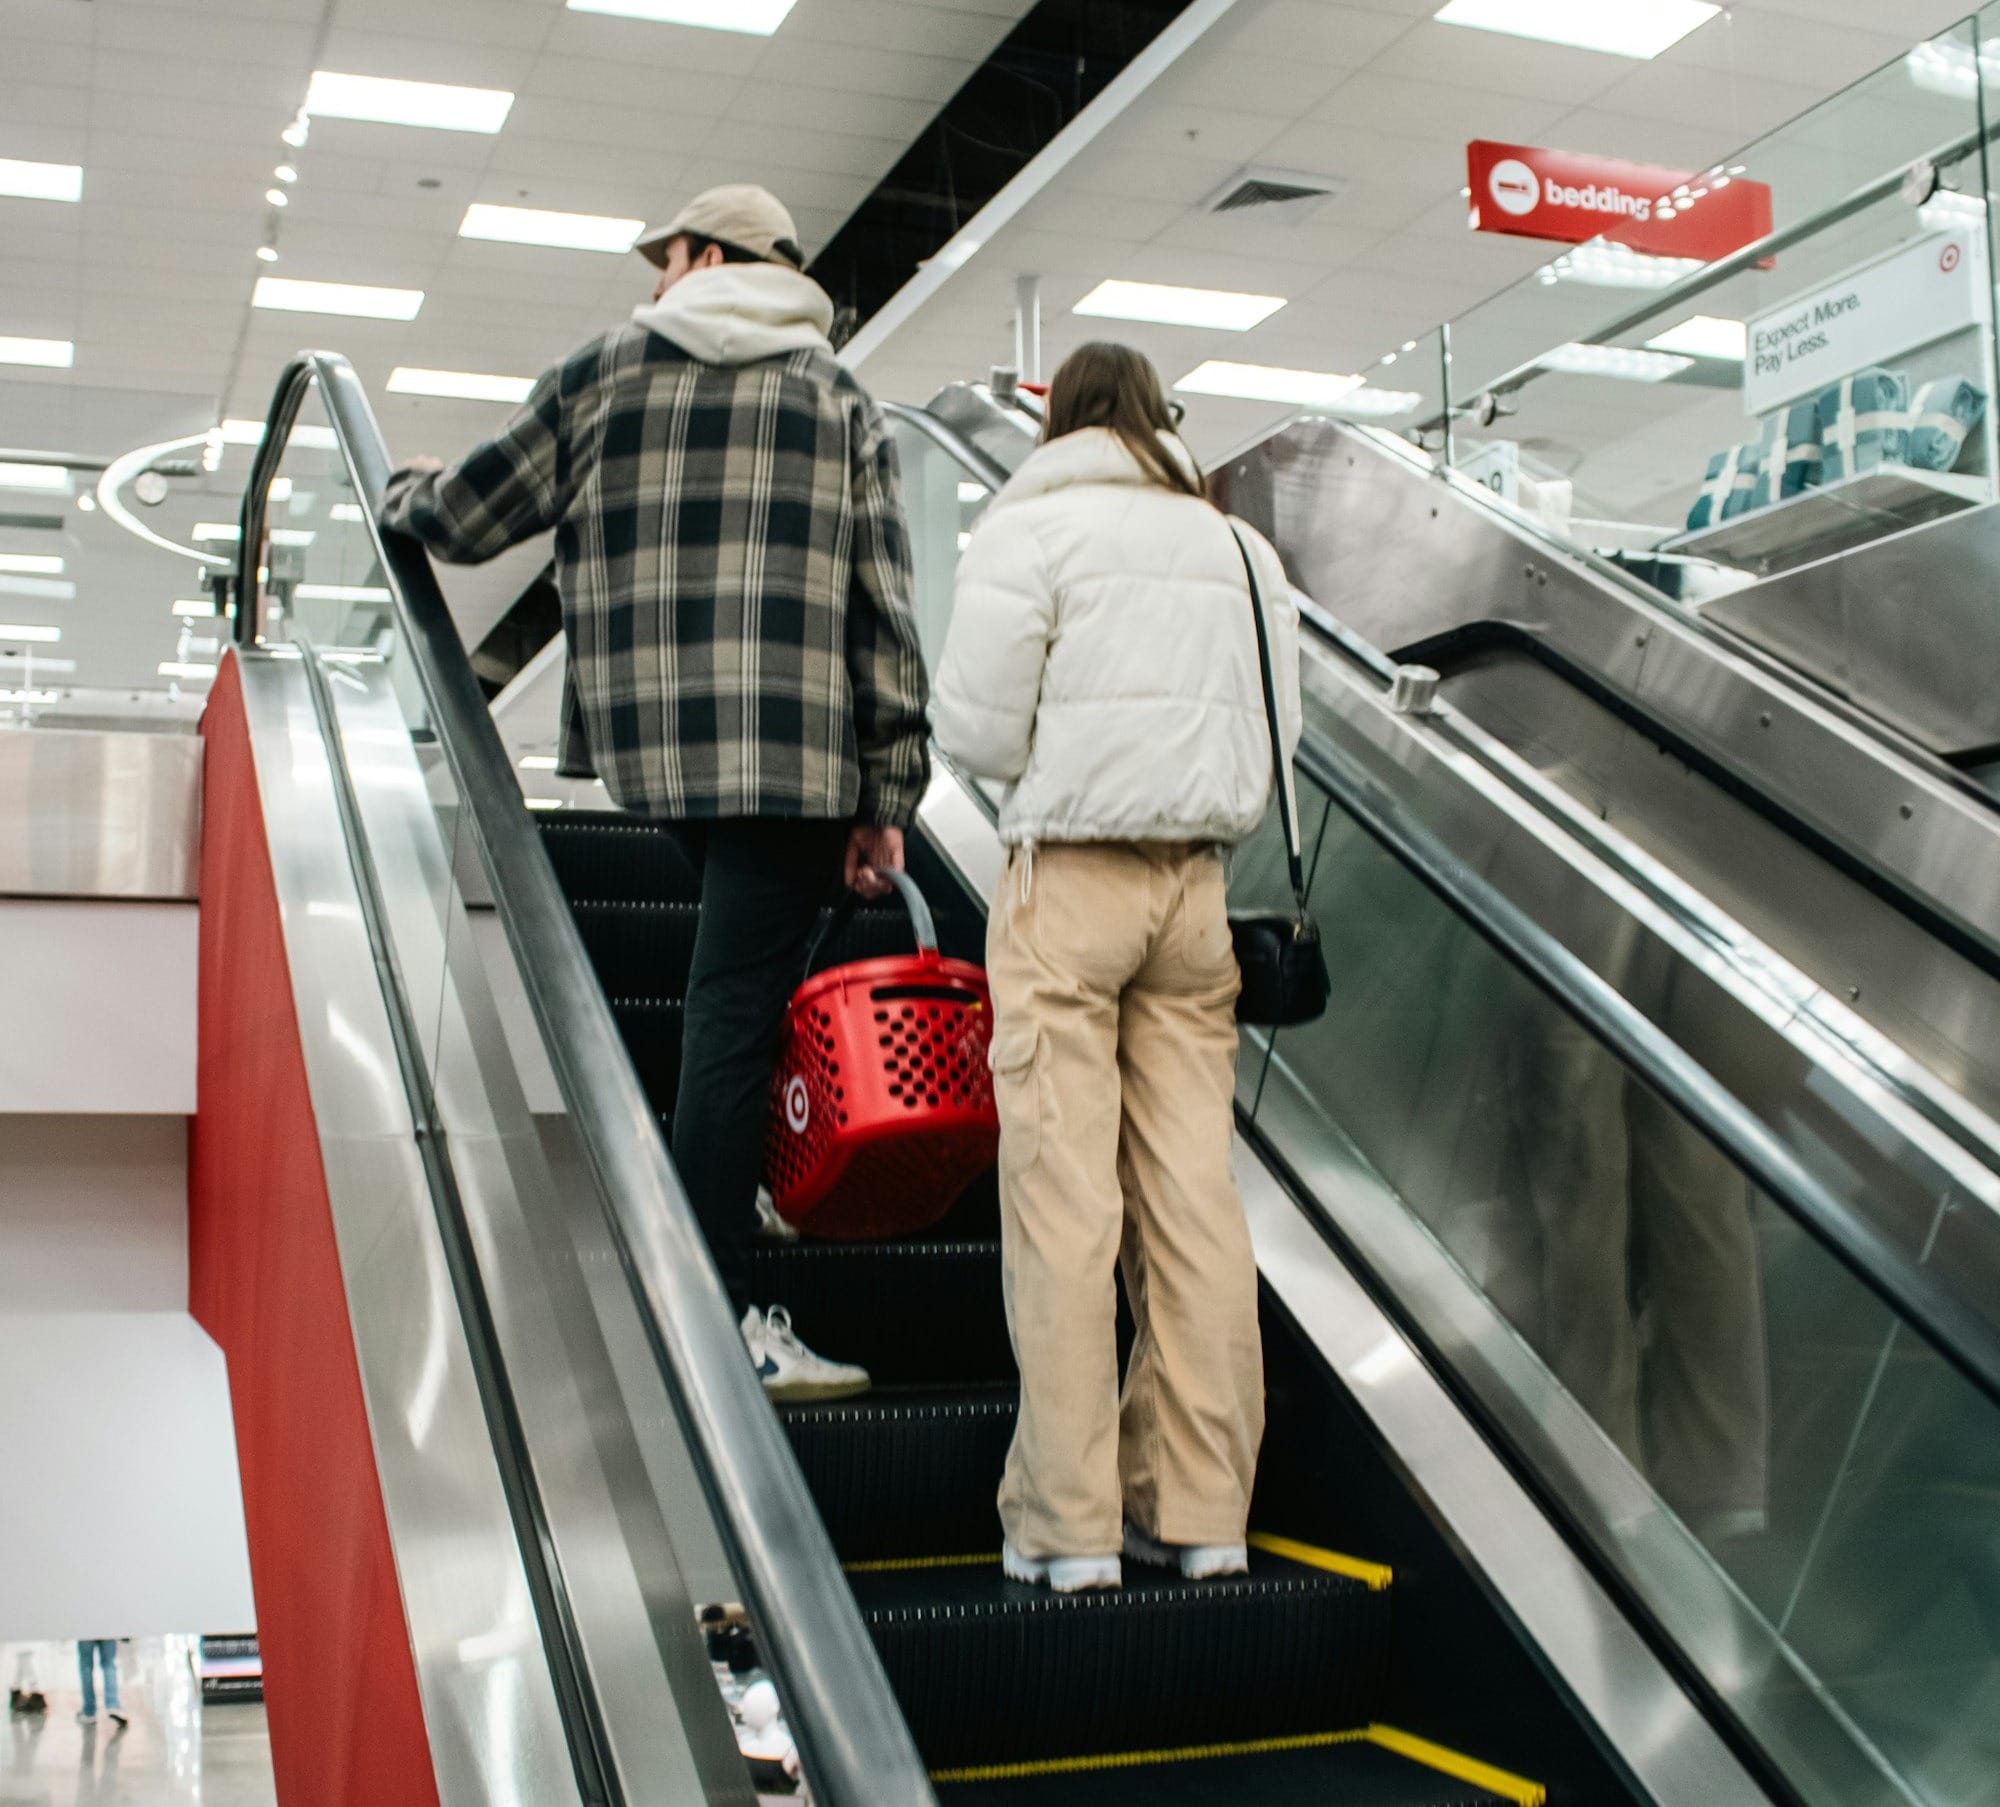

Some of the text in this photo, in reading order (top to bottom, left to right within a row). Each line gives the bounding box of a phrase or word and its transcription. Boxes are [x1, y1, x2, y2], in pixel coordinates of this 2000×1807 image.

[1545, 178, 1651, 221] bedding
[1755, 293, 1860, 352] Expect More.
[1755, 332, 1829, 376] Pay Less.
